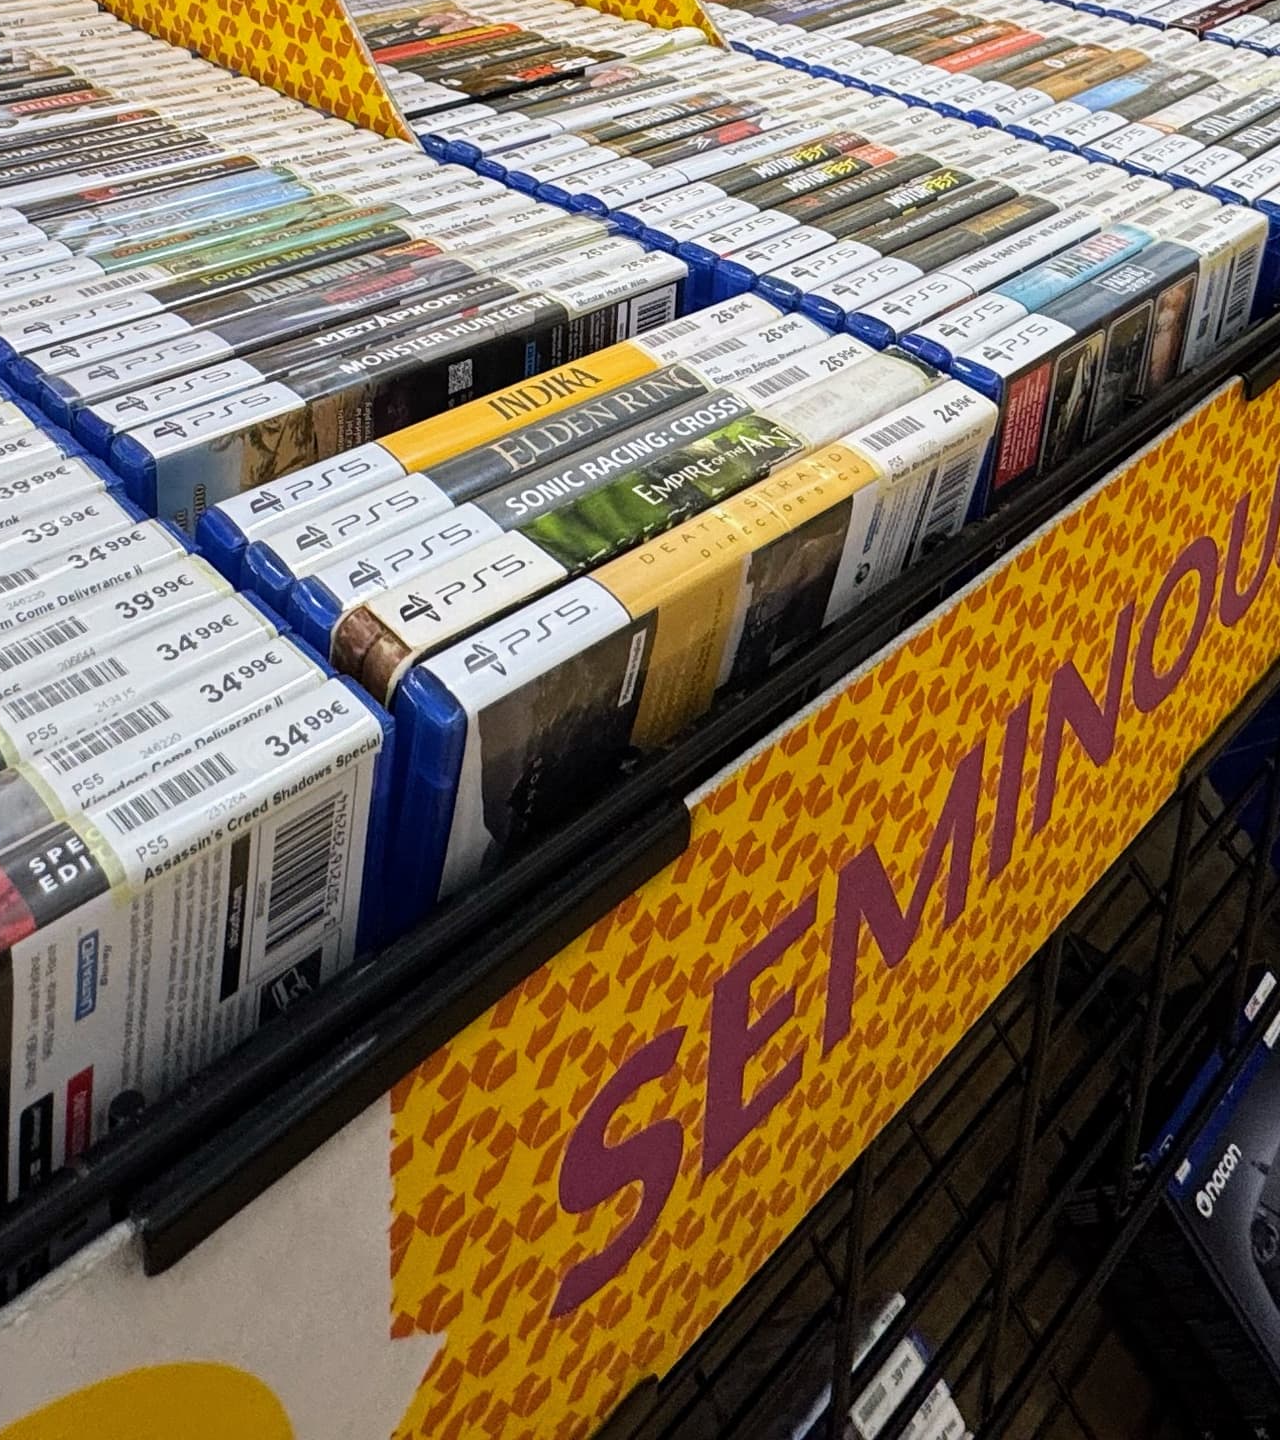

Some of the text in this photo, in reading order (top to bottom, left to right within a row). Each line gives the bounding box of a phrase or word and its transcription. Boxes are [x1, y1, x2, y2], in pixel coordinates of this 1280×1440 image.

[71, 137, 154, 167] FALLEN
[752, 140, 829, 179] MOTORFEST
[201, 255, 280, 285] Forgive
[961, 250, 998, 277] FINAL
[1053, 208, 1090, 234] REMAKE
[1054, 230, 1139, 278] MANEATER
[246, 266, 302, 302] ALAN
[338, 304, 528, 375] MONSTER HUNTER
[487, 365, 603, 422] INDIKA
[491, 406, 620, 474] ELDEN
[290, 455, 377, 502] PS5
[505, 429, 676, 516] SONIC RACING:
[632, 445, 746, 506] EMPIRE THE
[639, 511, 730, 567] DEATH
[15, 601, 55, 624] Come
[57, 570, 129, 608] Deliverance
[500, 596, 598, 656] PS5
[143, 734, 382, 885] Assassin's Creed Shadows Special
[135, 835, 170, 862] PS5
[1206, 1142, 1243, 1206] nacon
